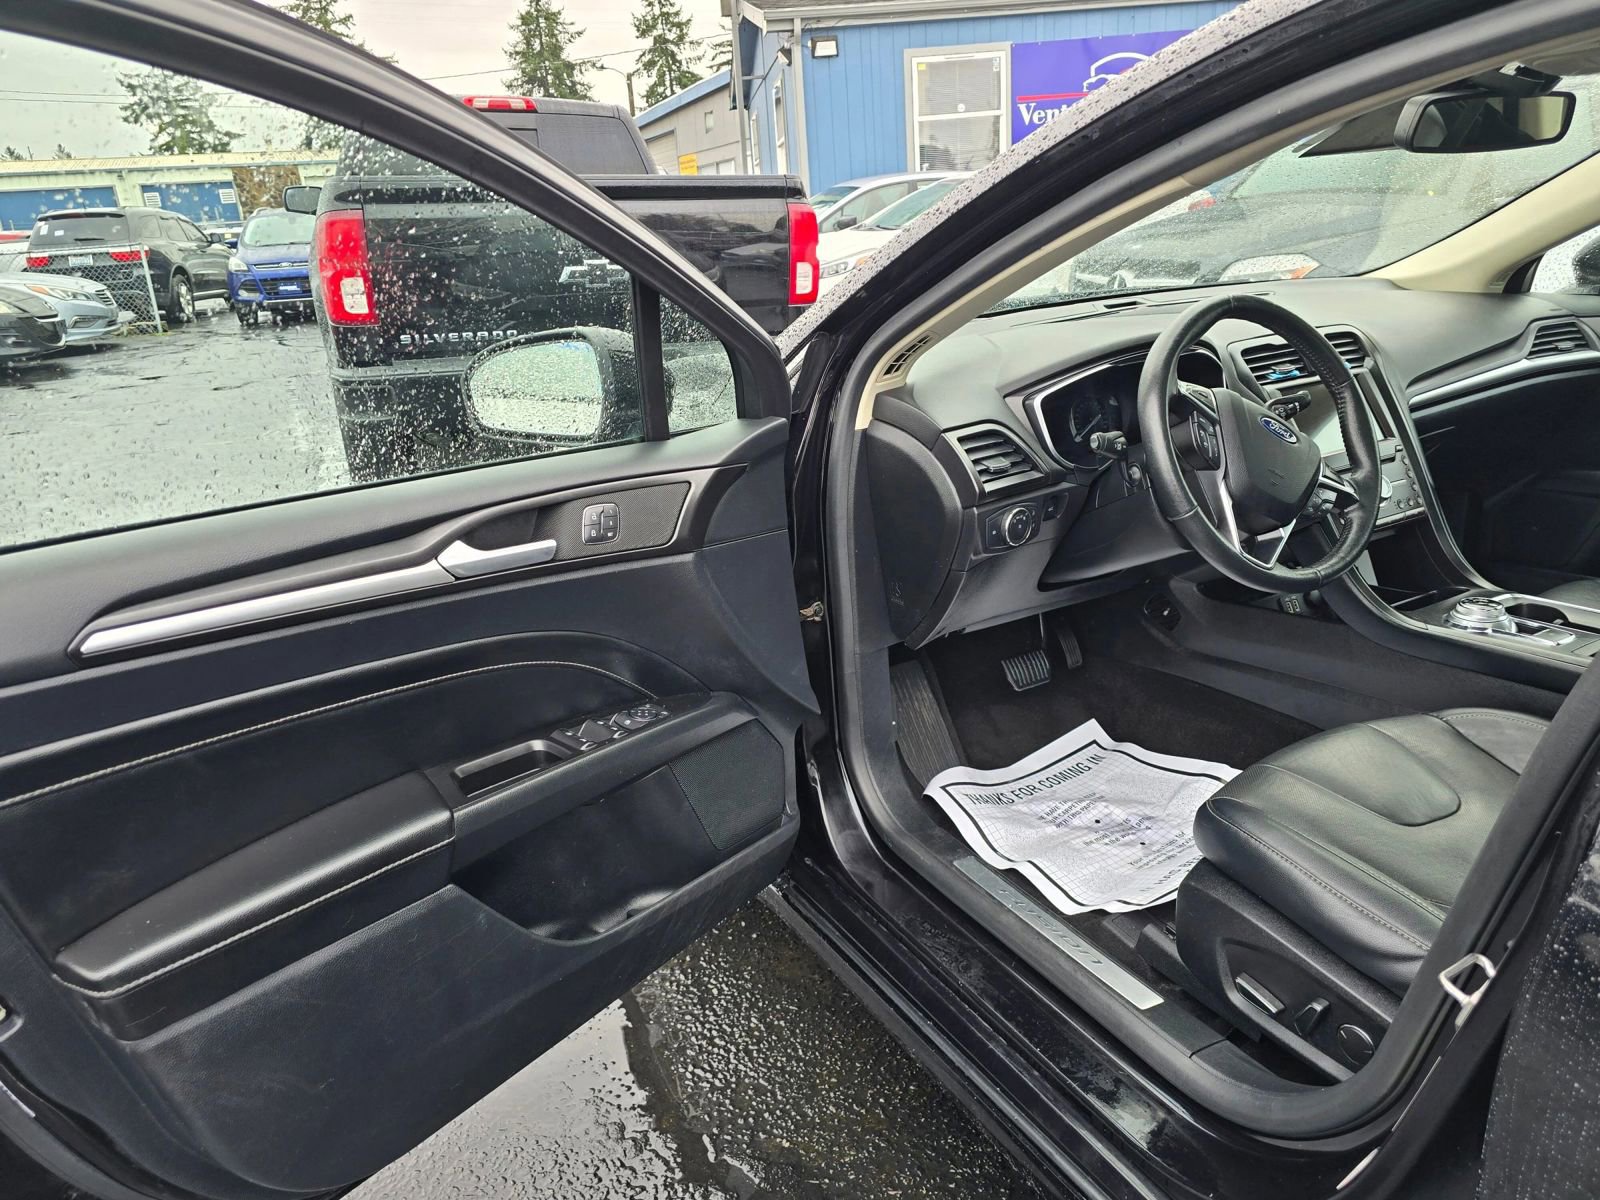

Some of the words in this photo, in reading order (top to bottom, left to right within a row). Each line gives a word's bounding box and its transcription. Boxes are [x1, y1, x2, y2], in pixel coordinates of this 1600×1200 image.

[400, 329, 518, 344] SILVERADO
[964, 792, 1015, 808] THANKS
[1010, 784, 1042, 799] FOR
[1037, 761, 1092, 789] COMING
[1086, 753, 1107, 766] IN
